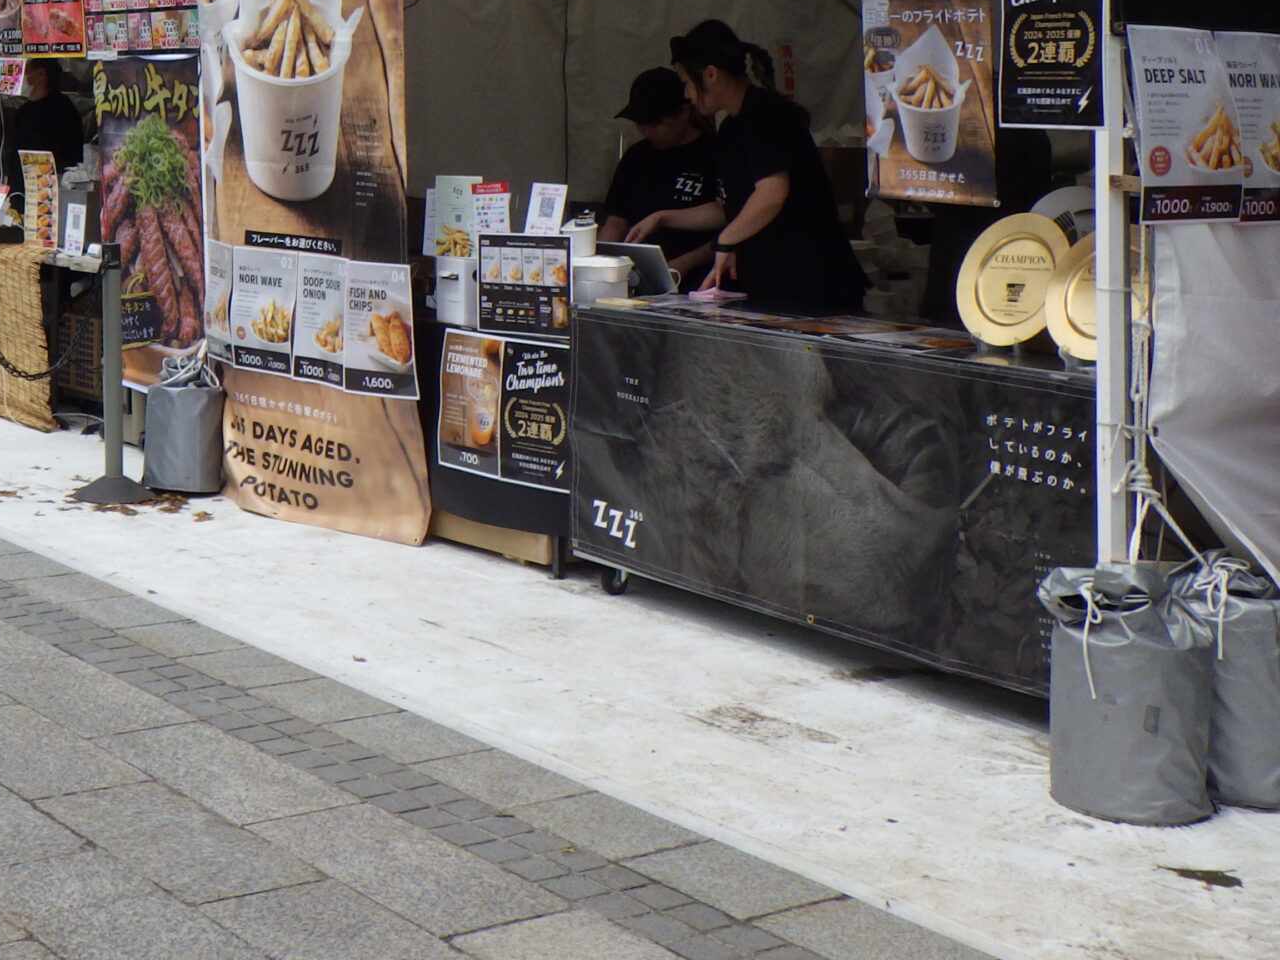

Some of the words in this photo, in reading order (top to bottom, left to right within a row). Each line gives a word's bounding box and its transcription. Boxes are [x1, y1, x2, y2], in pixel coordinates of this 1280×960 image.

[866, 7, 987, 25] 日本一のフライドポテト
[1027, 40, 1076, 63] 2連覇
[1144, 68, 1175, 84] DEEP
[1180, 68, 1207, 84] SALT
[1228, 73, 1257, 88] NORI
[995, 254, 1046, 265] CHAMPION
[238, 273, 259, 285] NORI
[261, 276, 283, 288] WAVE
[303, 276, 323, 288] DOOP
[391, 271, 406, 283] 04
[303, 288, 326, 300] ONION
[349, 287, 367, 300] FISH
[368, 289, 387, 300] AND
[349, 299, 373, 312] CHIPS
[447, 352, 488, 367] FERMENTED
[446, 363, 482, 377] LEMONADE
[505, 372, 565, 394] Champions
[616, 391, 650, 404] HOKKAIDO
[252, 421, 297, 448] DAYS
[986, 414, 1088, 442] ポテトがフライ
[989, 437, 1083, 468] しているのか、
[225, 441, 256, 466] THE
[262, 451, 354, 488] STUNNING
[240, 475, 318, 510] POTATO
[629, 509, 644, 522] 365
